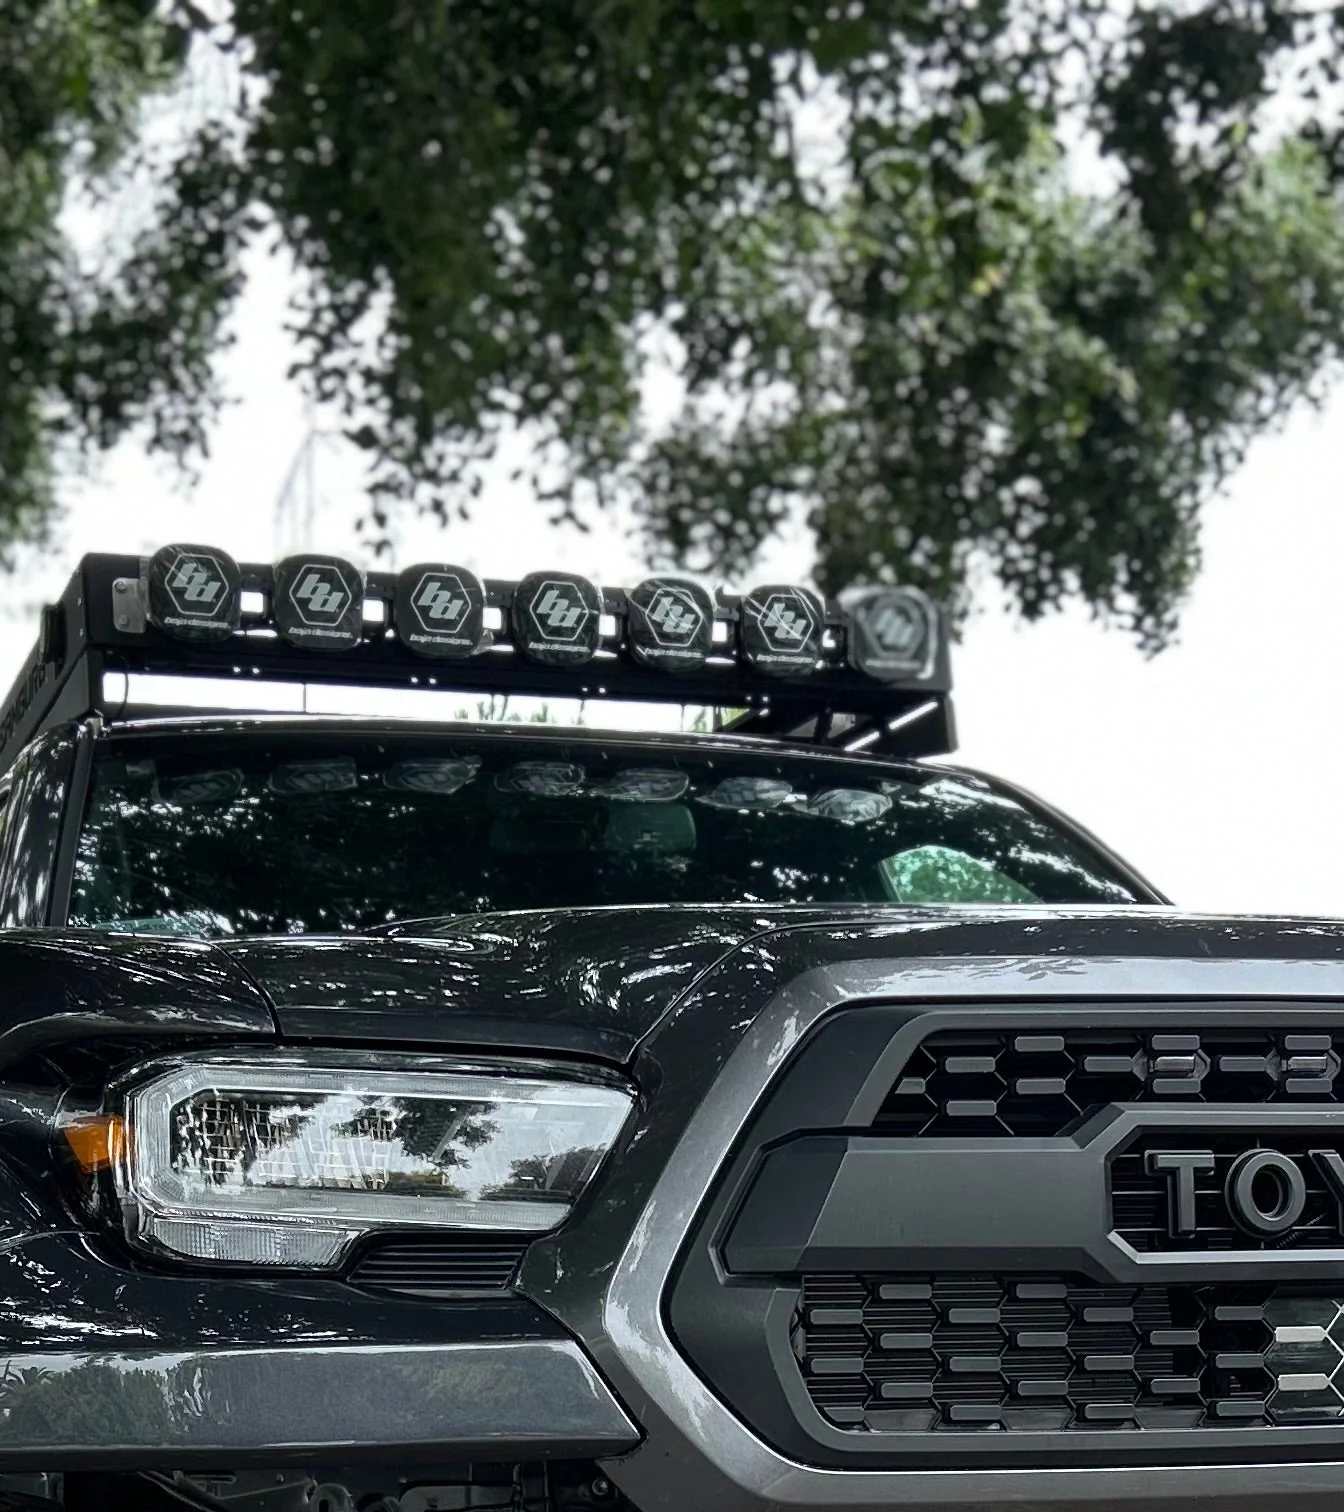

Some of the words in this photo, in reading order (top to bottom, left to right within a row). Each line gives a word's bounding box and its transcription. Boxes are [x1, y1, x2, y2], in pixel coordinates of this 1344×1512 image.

[171, 562, 222, 603] bd
[296, 573, 345, 613] bd
[417, 582, 464, 620] bd
[536, 590, 582, 628] bd
